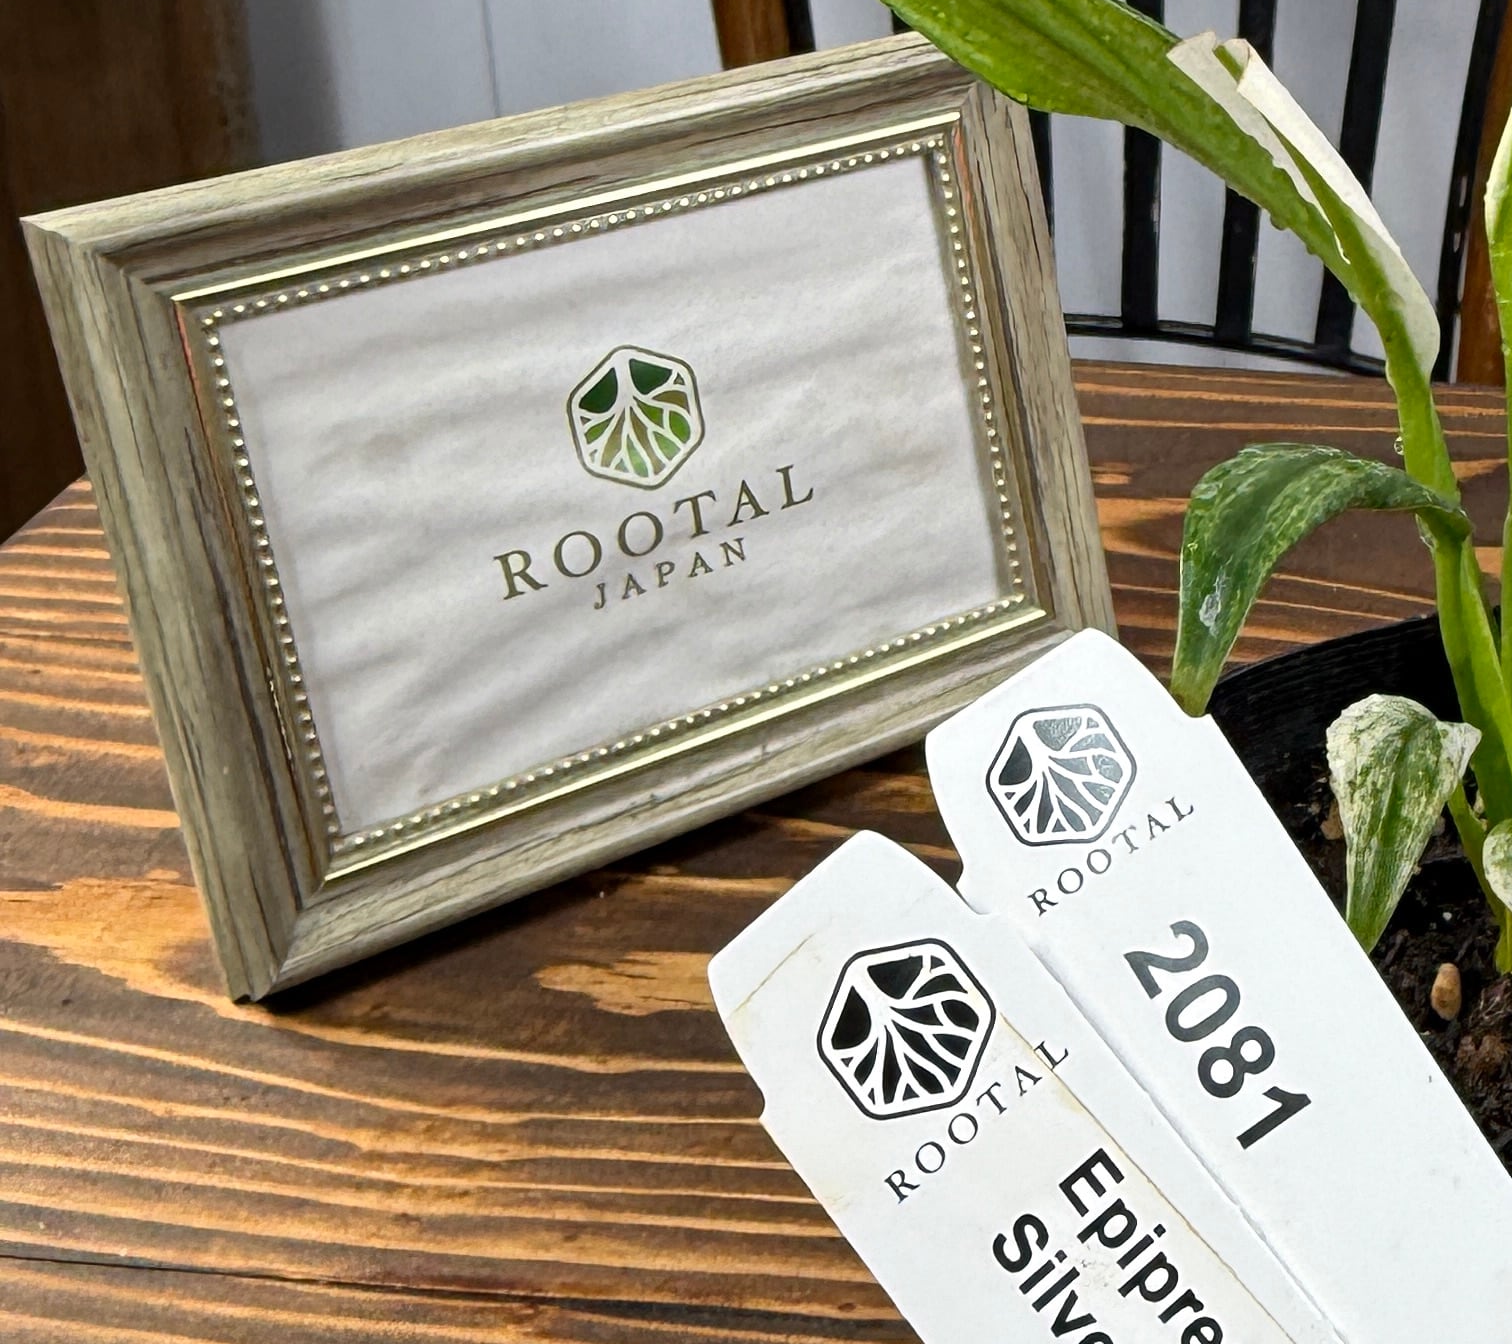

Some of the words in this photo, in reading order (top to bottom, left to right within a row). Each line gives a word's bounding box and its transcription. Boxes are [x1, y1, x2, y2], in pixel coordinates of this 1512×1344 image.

[493, 464, 814, 599] ROOTAL
[593, 537, 747, 610] JAPAN
[1027, 796, 1195, 916] ROOTAL
[1123, 920, 1312, 1149] 2081
[884, 1040, 1070, 1204] ROOTAL
